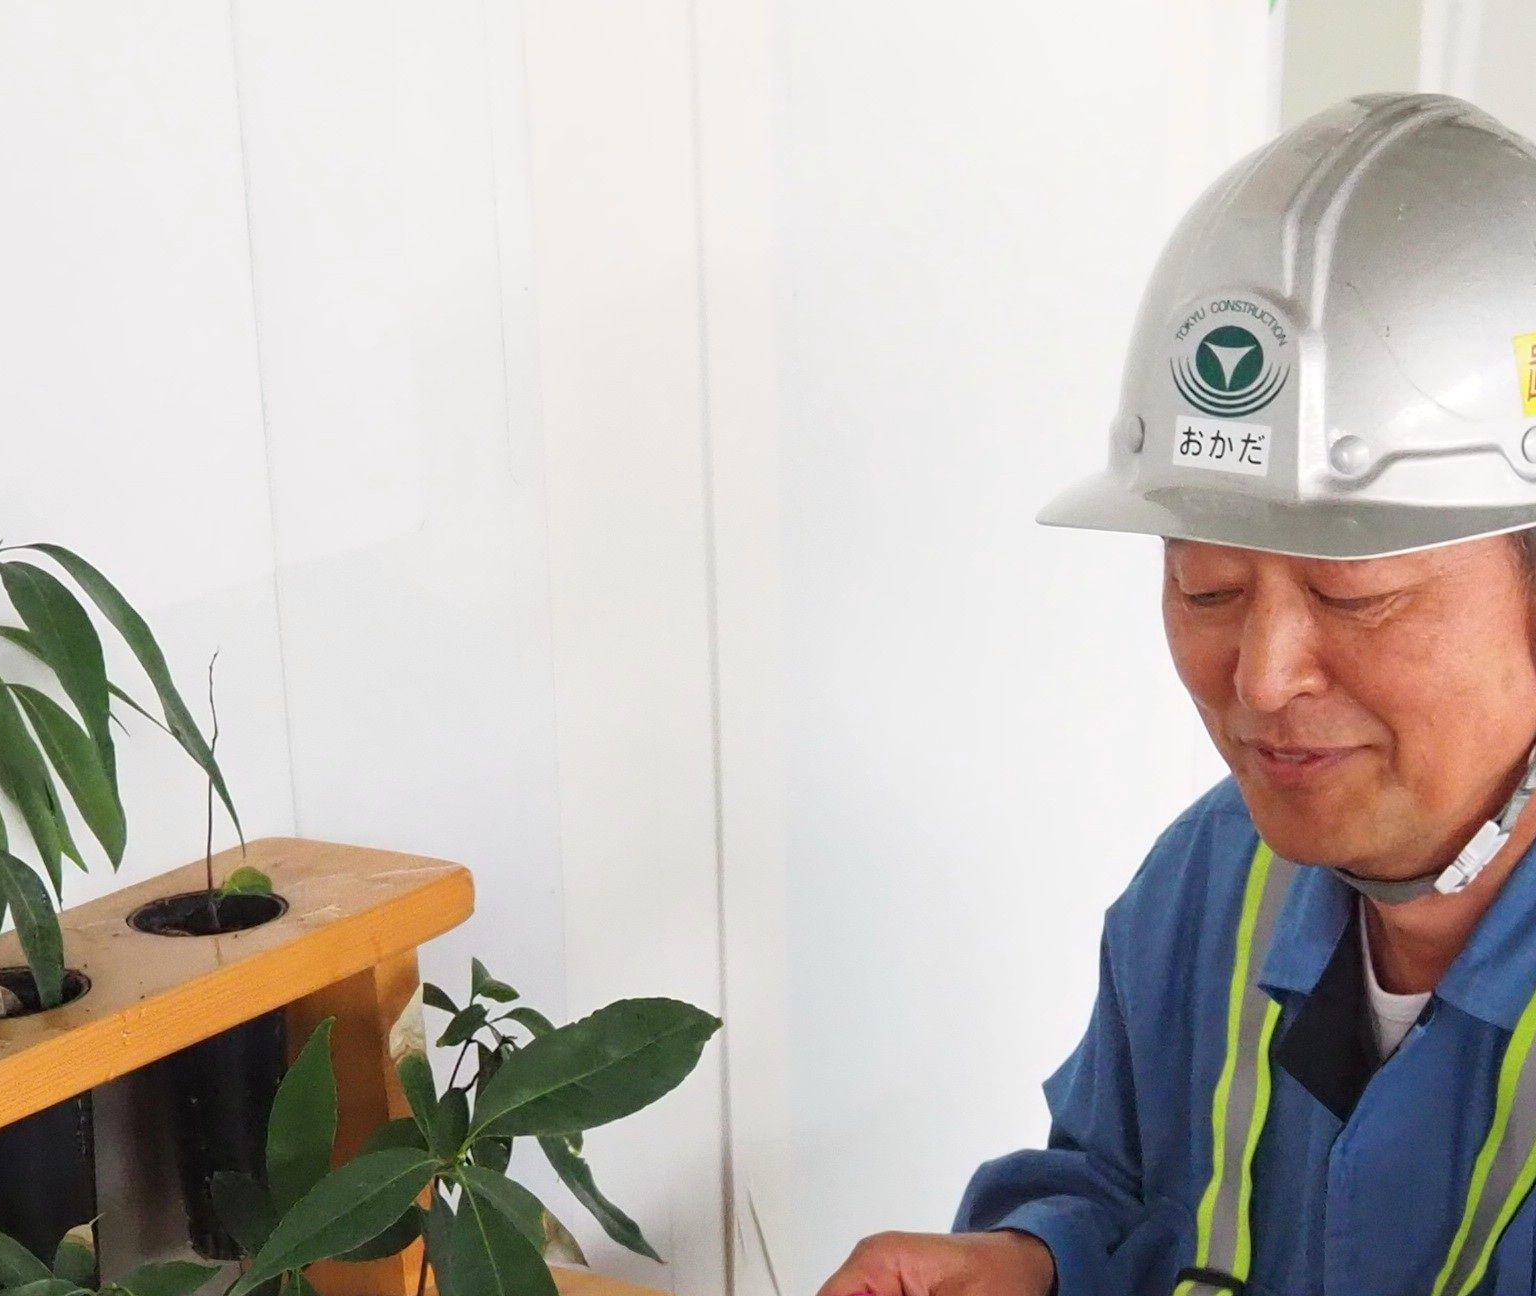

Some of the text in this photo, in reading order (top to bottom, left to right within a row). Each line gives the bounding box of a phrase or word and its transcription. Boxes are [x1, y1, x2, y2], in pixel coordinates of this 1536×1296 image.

[1175, 300, 1288, 347] TOKYU CONSTRUCTION
[1180, 426, 1265, 465] おかだ
